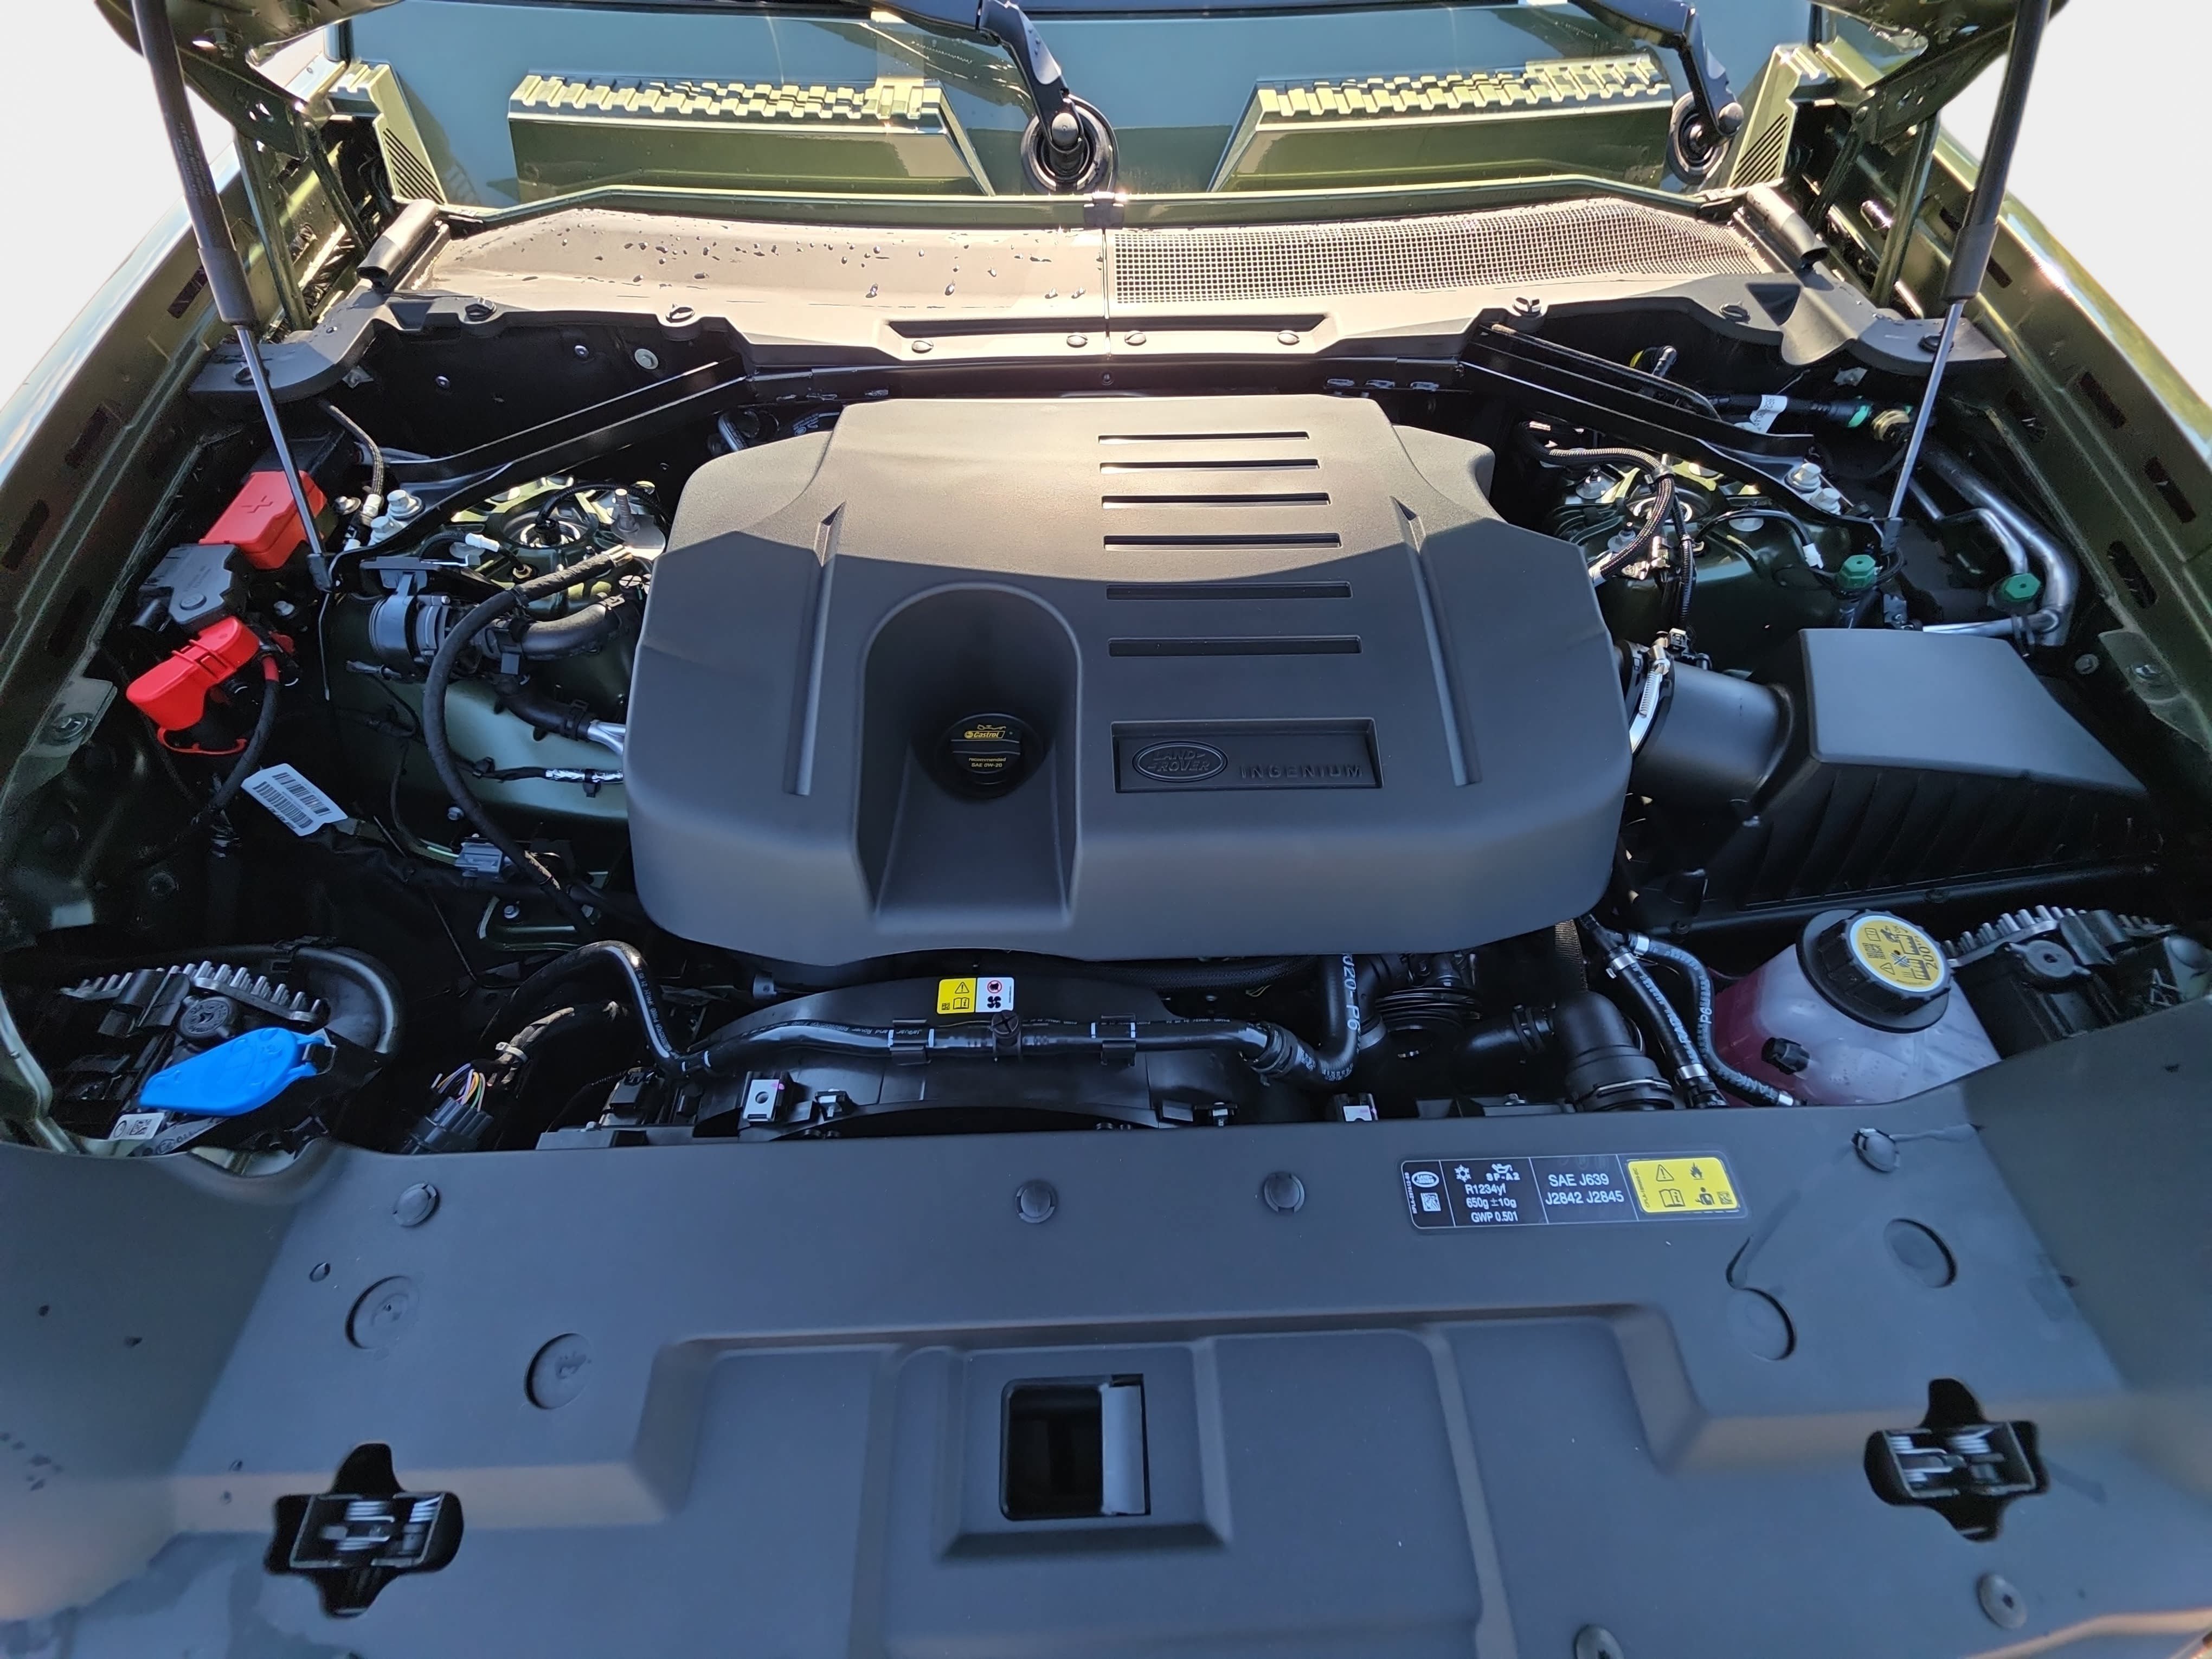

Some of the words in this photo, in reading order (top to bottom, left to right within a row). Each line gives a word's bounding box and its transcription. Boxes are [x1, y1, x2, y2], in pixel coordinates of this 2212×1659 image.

[1240, 764, 1364, 779] INGENIUM
[1918, 946, 1939, 970] 200
[1486, 1172, 1521, 1181] SP-A2
[1548, 1174, 1577, 1187] SAE
[1579, 1173, 1610, 1186] J639
[1465, 1182, 1507, 1196] R1234yf
[1466, 1197, 1489, 1210] 650g
[1490, 1198, 1517, 1208] ±10g
[1545, 1191, 1584, 1205] J2842
[1586, 1190, 1624, 1204] J2845
[1471, 1212, 1494, 1223] GWP
[1495, 1211, 1519, 1222] 0.501
